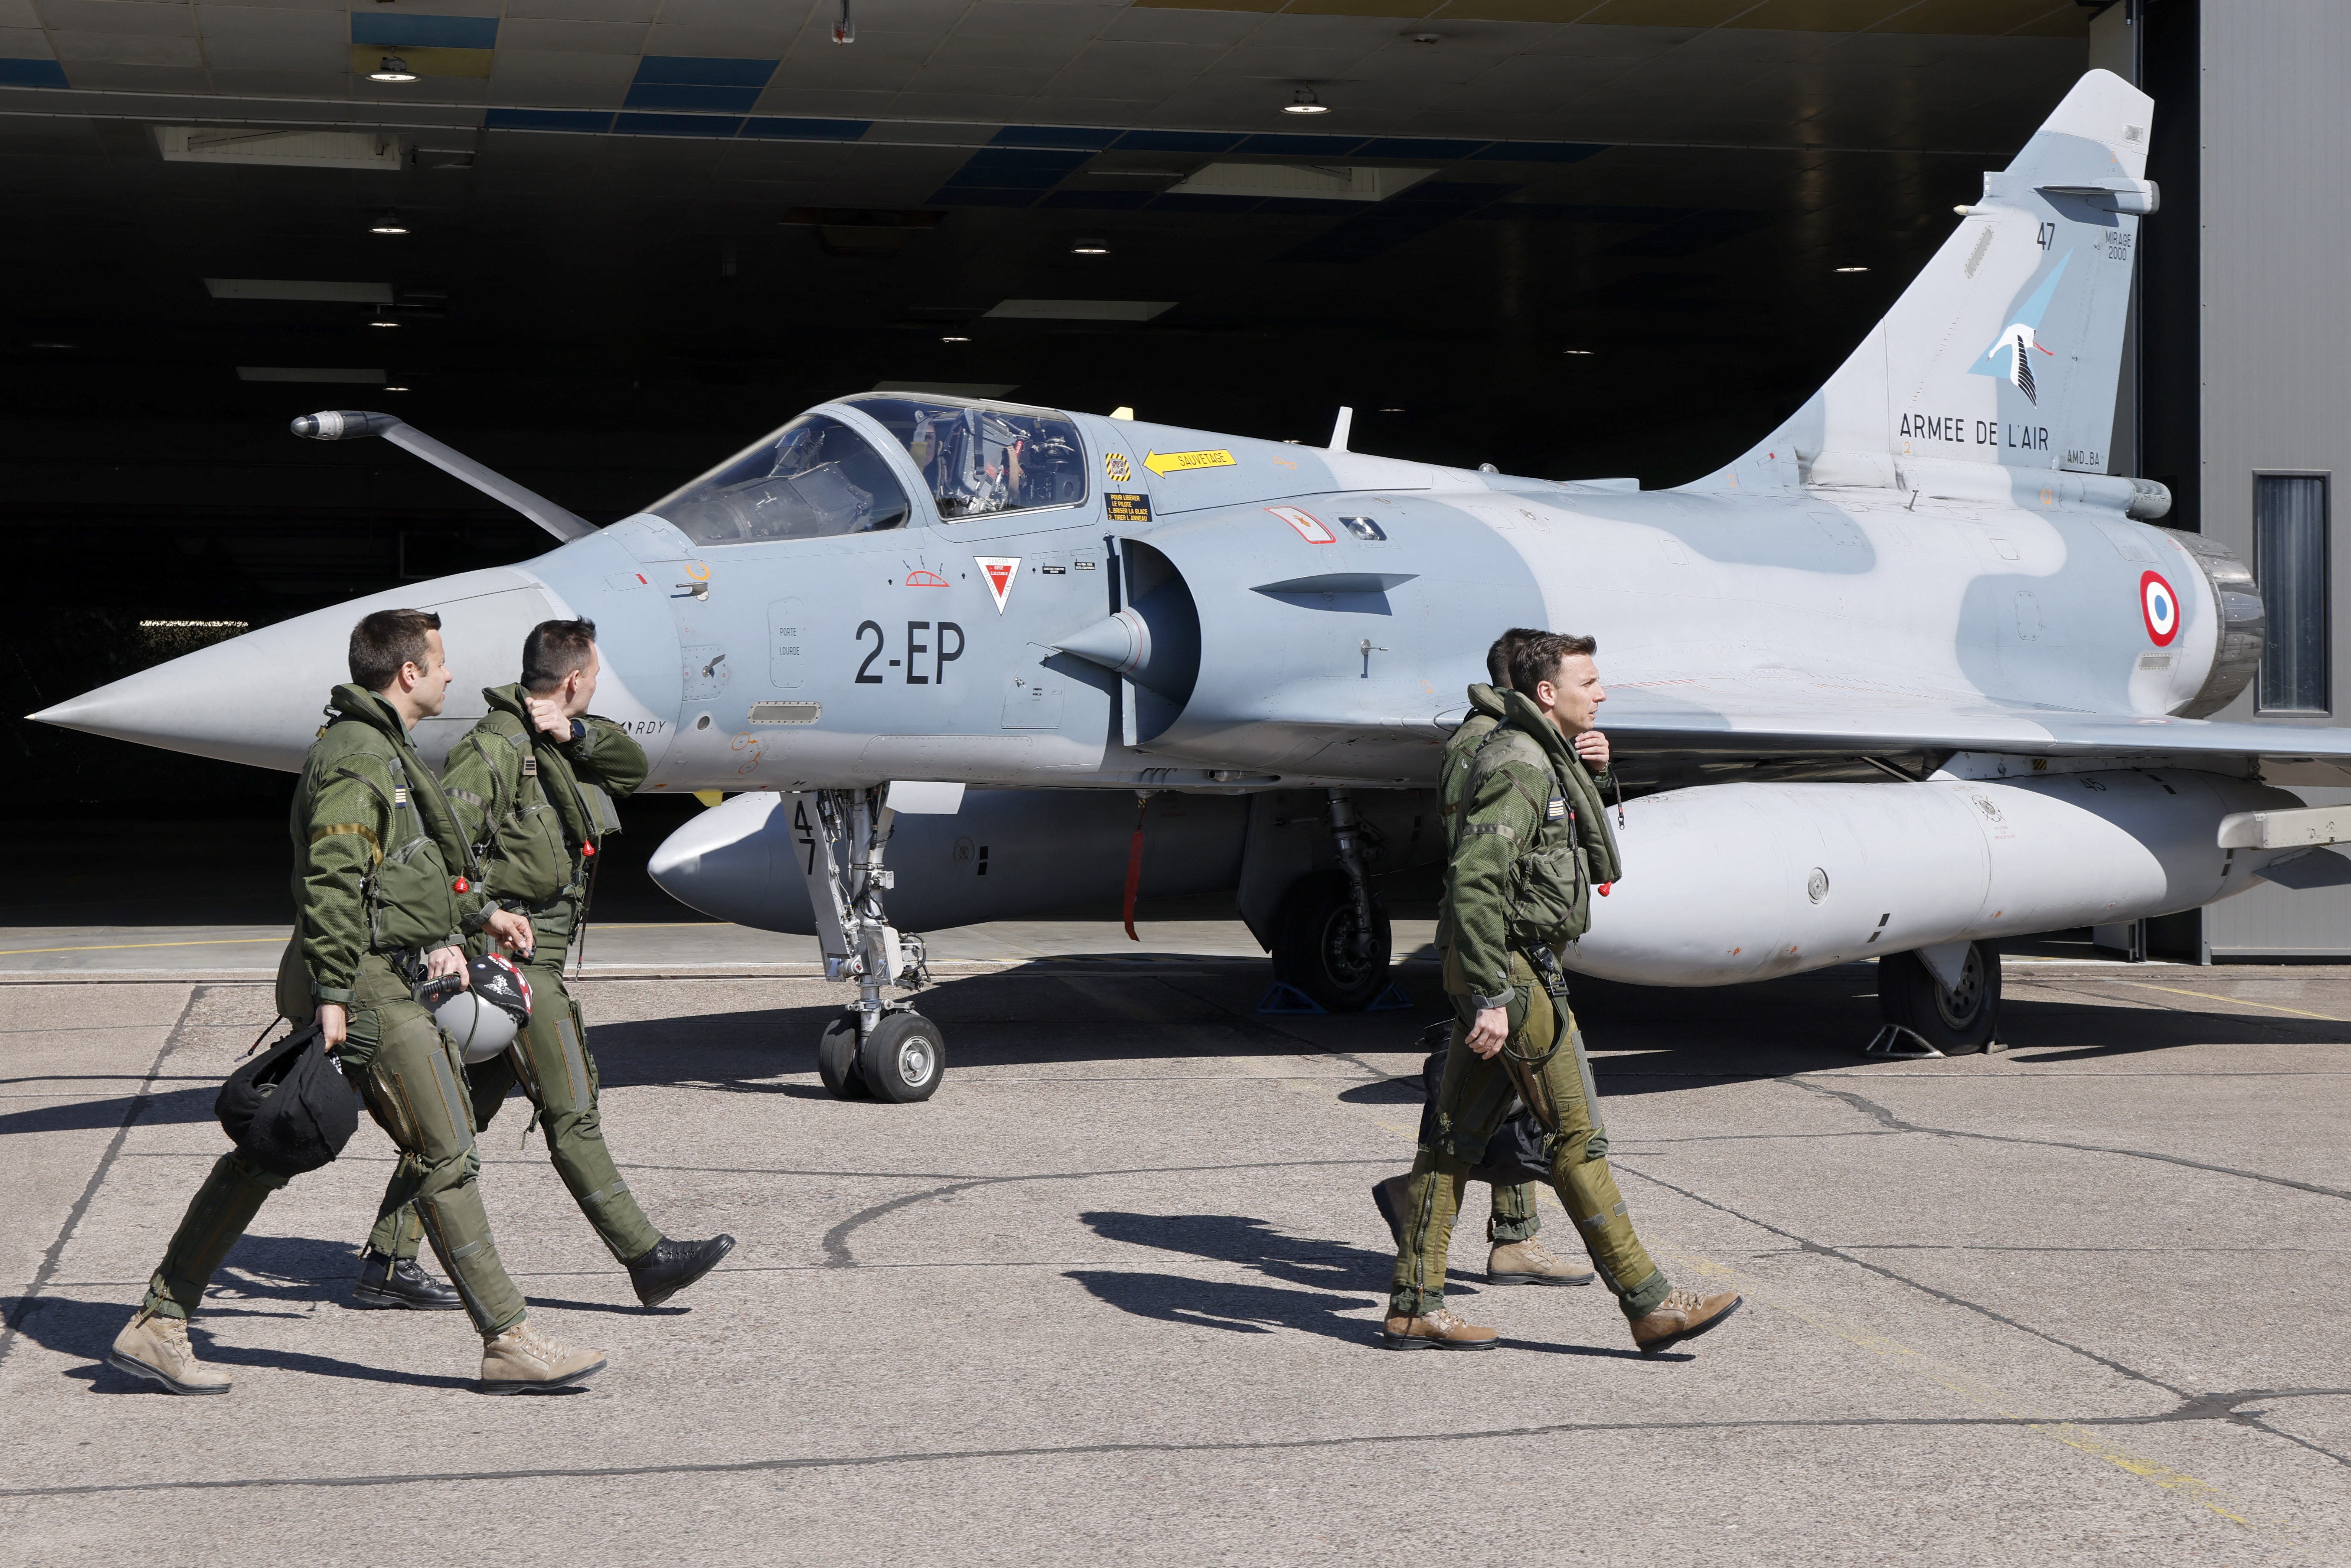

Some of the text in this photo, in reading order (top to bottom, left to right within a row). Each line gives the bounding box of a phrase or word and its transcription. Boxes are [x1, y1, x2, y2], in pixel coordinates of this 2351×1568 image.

[2037, 222, 2055, 251] 47
[2106, 230, 2131, 247] MIRAGE
[2109, 246, 2127, 261] 2000
[1900, 413, 2048, 451] ARMEE DE L'AIR
[1178, 453, 1227, 467] SAUVETAGE
[983, 571, 998, 597] DANGER
[1003, 571, 1015, 597] DANGER
[780, 628, 796, 636] PORTE
[779, 646, 800, 655] LOURDE
[855, 620, 965, 684] 2-EP
[635, 721, 666, 734] RDY
[2079, 778, 2106, 791] 45
